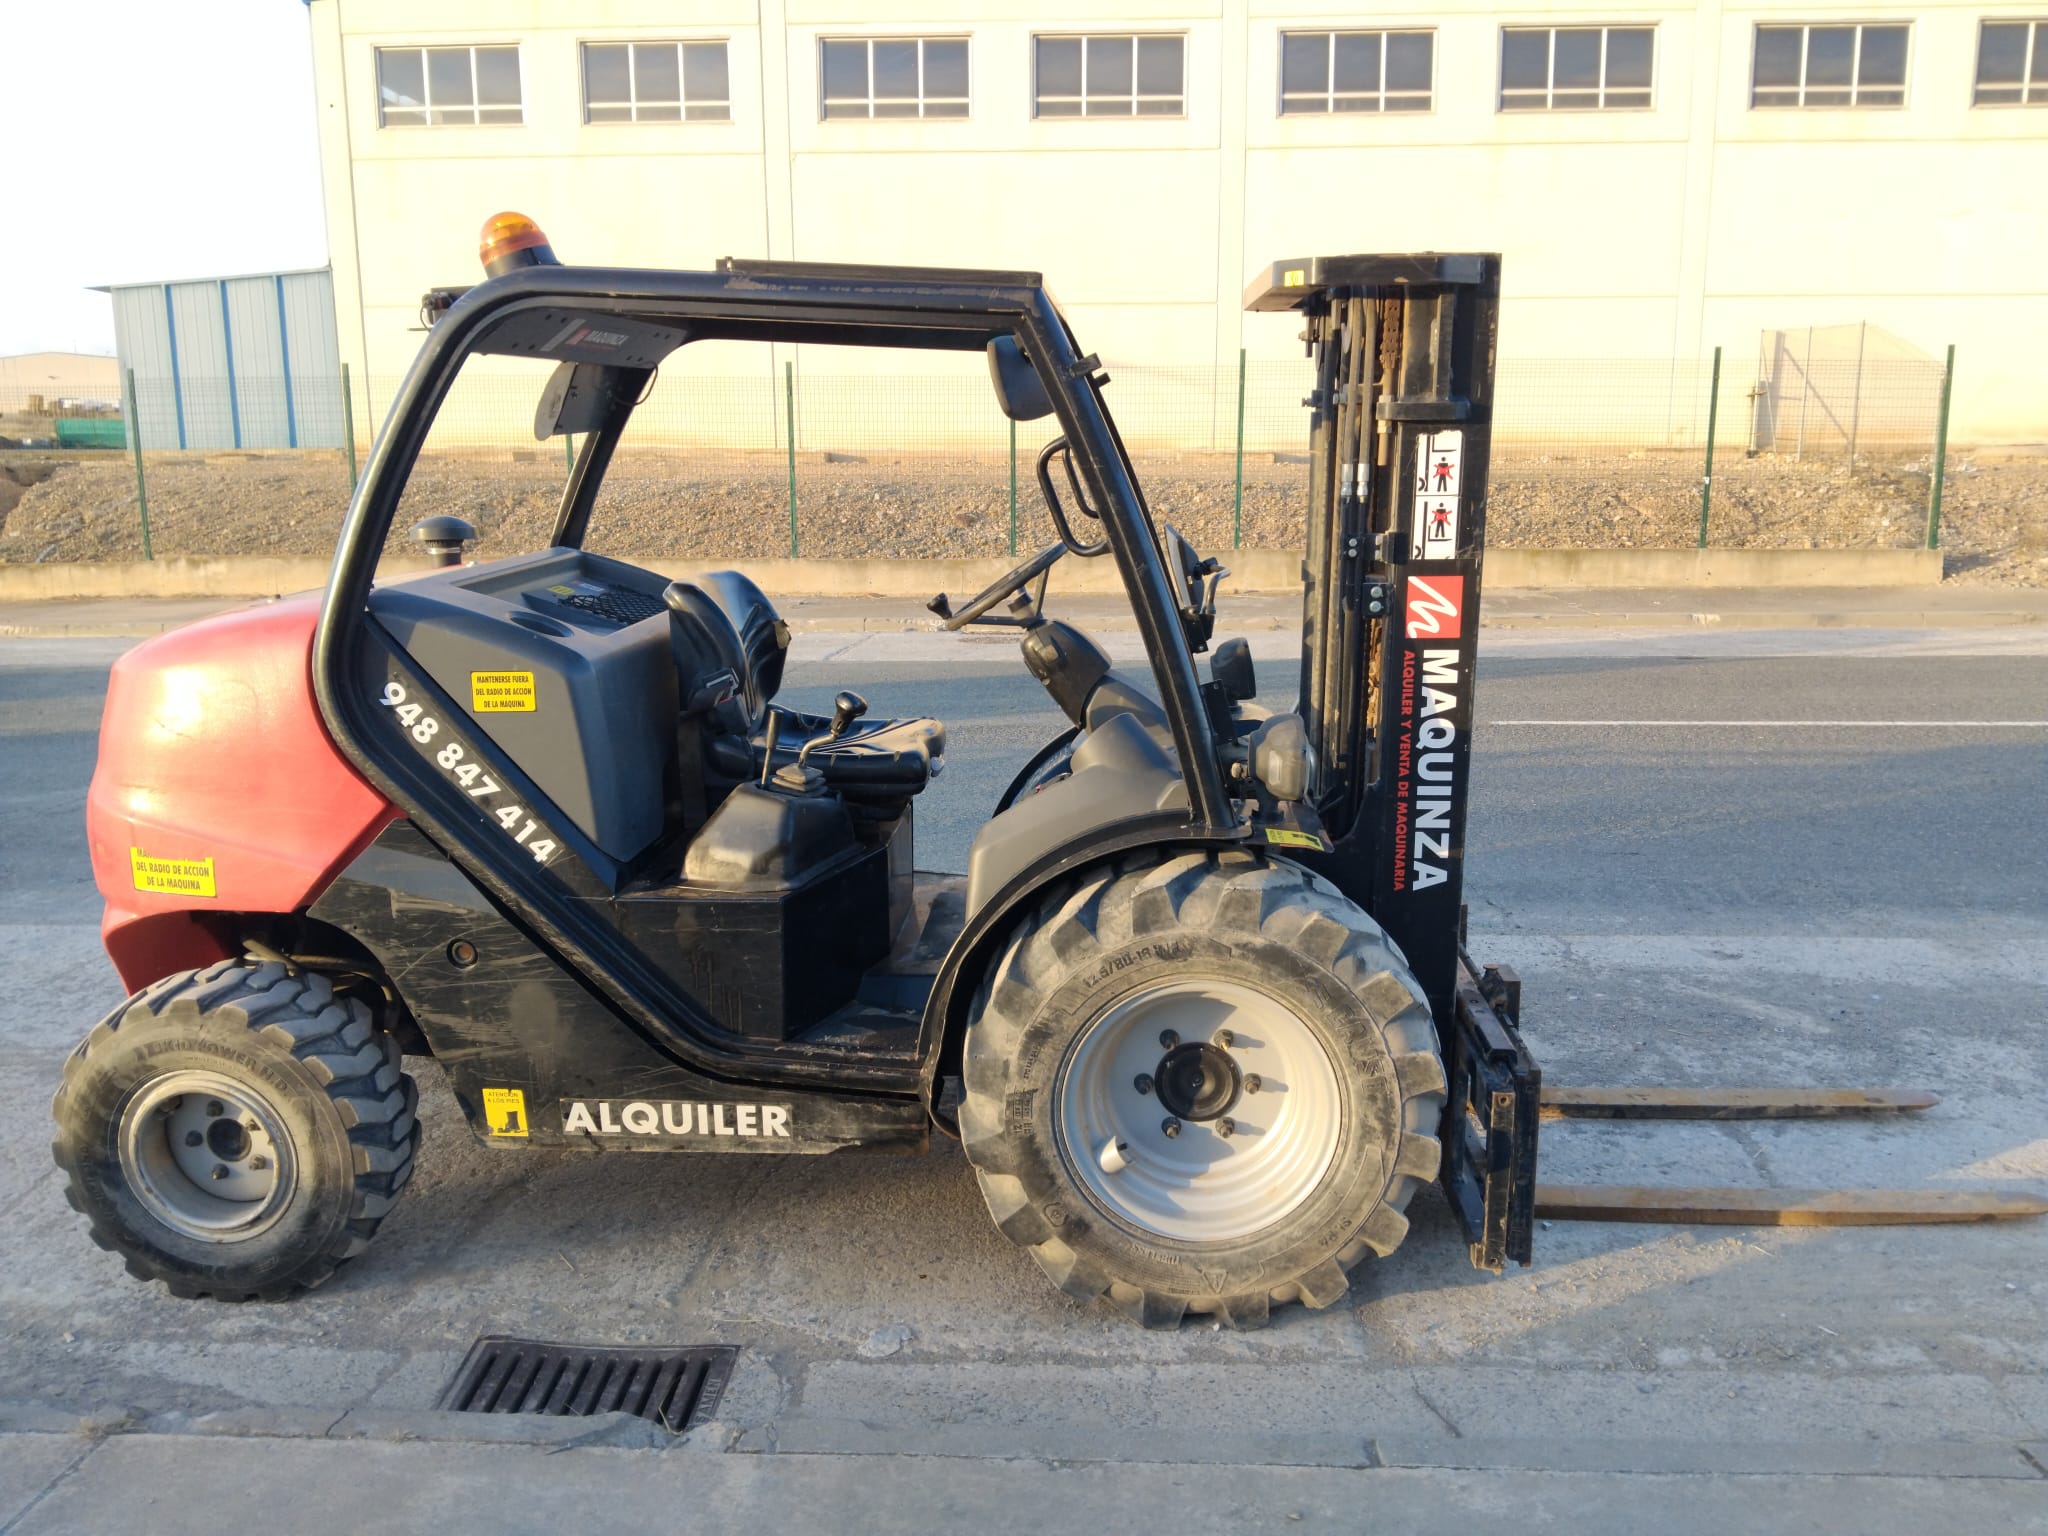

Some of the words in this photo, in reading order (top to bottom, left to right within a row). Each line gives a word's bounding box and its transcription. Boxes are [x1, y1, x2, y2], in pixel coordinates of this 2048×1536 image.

[476, 675, 510, 683] MANTENERSE
[512, 675, 529, 683] FUERA
[1401, 650, 1416, 715] ALQUILER
[475, 688, 485, 696] DEL
[487, 688, 503, 696] RADIO
[505, 688, 511, 696] DE
[483, 700, 491, 708] DE
[491, 700, 499, 708] LA
[1400, 720, 1412, 728] Y
[1398, 733, 1411, 777] VENTA
[379, 681, 439, 744] 948
[436, 742, 501, 797] 847
[495, 805, 557, 863] 414
[1412, 650, 1460, 891] MAQUINZA
[1397, 781, 1409, 798] DE
[1393, 802, 1409, 892] MAQUINARIA
[136, 861, 148, 872] DEL
[149, 863, 171, 874] RADIO
[172, 865, 182, 875] DE
[184, 866, 210, 878] ACCION
[146, 876, 155, 886] DE
[157, 878, 165, 887] LA
[167, 878, 201, 891] MAQUINA
[564, 1102, 791, 1137] ALQUILER
